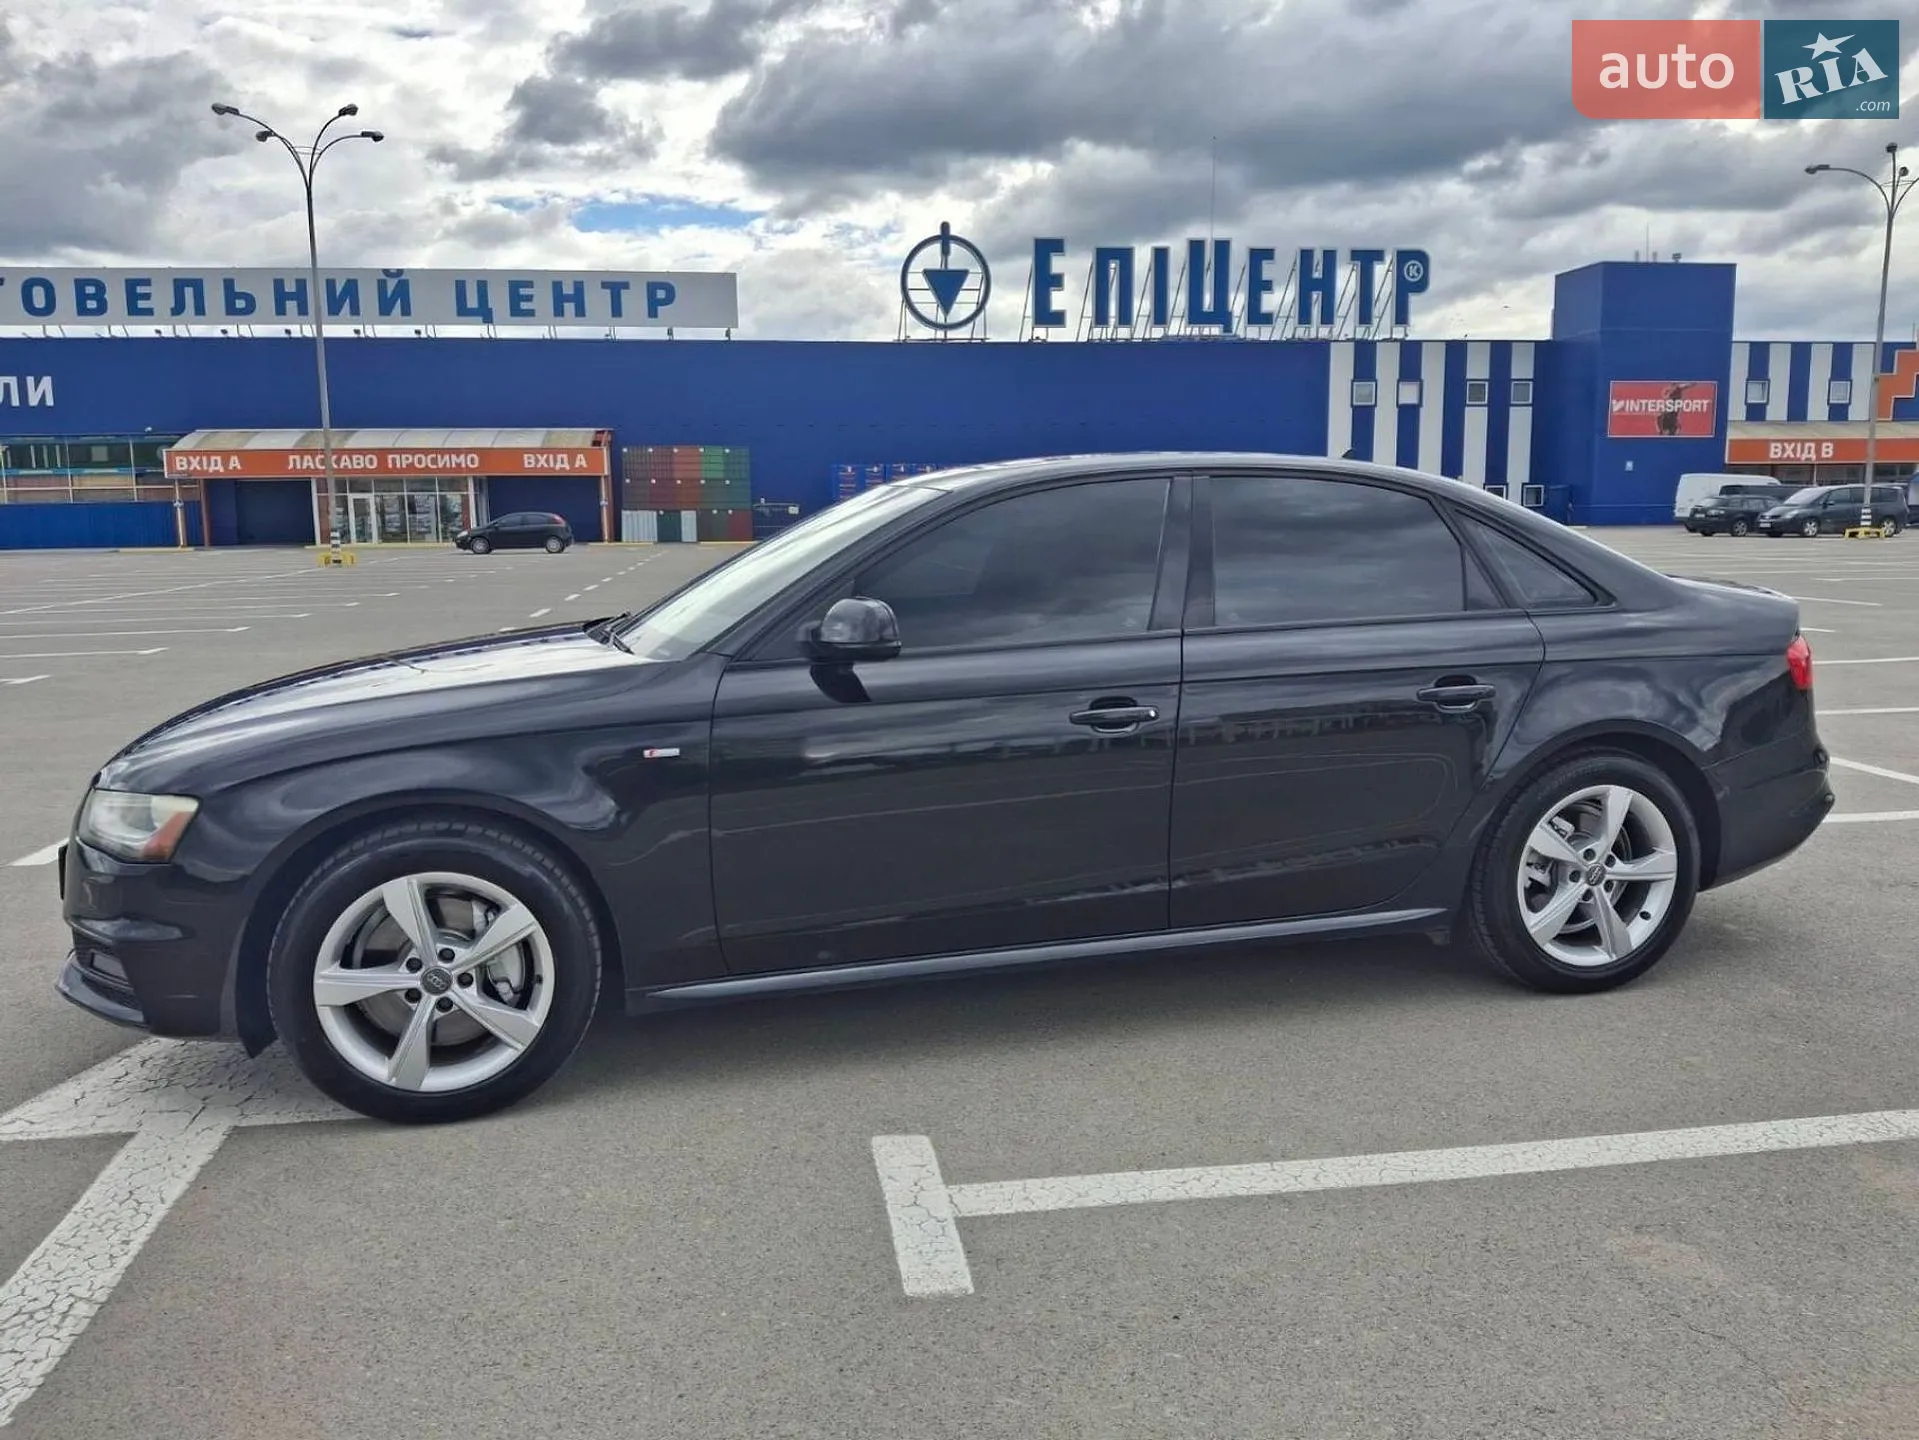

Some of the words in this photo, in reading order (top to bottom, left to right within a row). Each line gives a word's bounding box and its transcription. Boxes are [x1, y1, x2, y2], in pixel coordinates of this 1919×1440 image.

[1032, 237, 1430, 333] ЕПІЦЕНТР
[0, 269, 412, 318] ОВЕЛЬНИЙ
[455, 279, 676, 323] ЦЕНТР
[1625, 400, 1710, 413] INTERSPORT
[1769, 442, 1816, 460] ВХІД
[175, 456, 224, 473] ВХІД
[228, 456, 242, 470] А
[387, 454, 479, 469] ПРОСИМО
[523, 454, 570, 470] ВХІД
[575, 454, 588, 469] А
